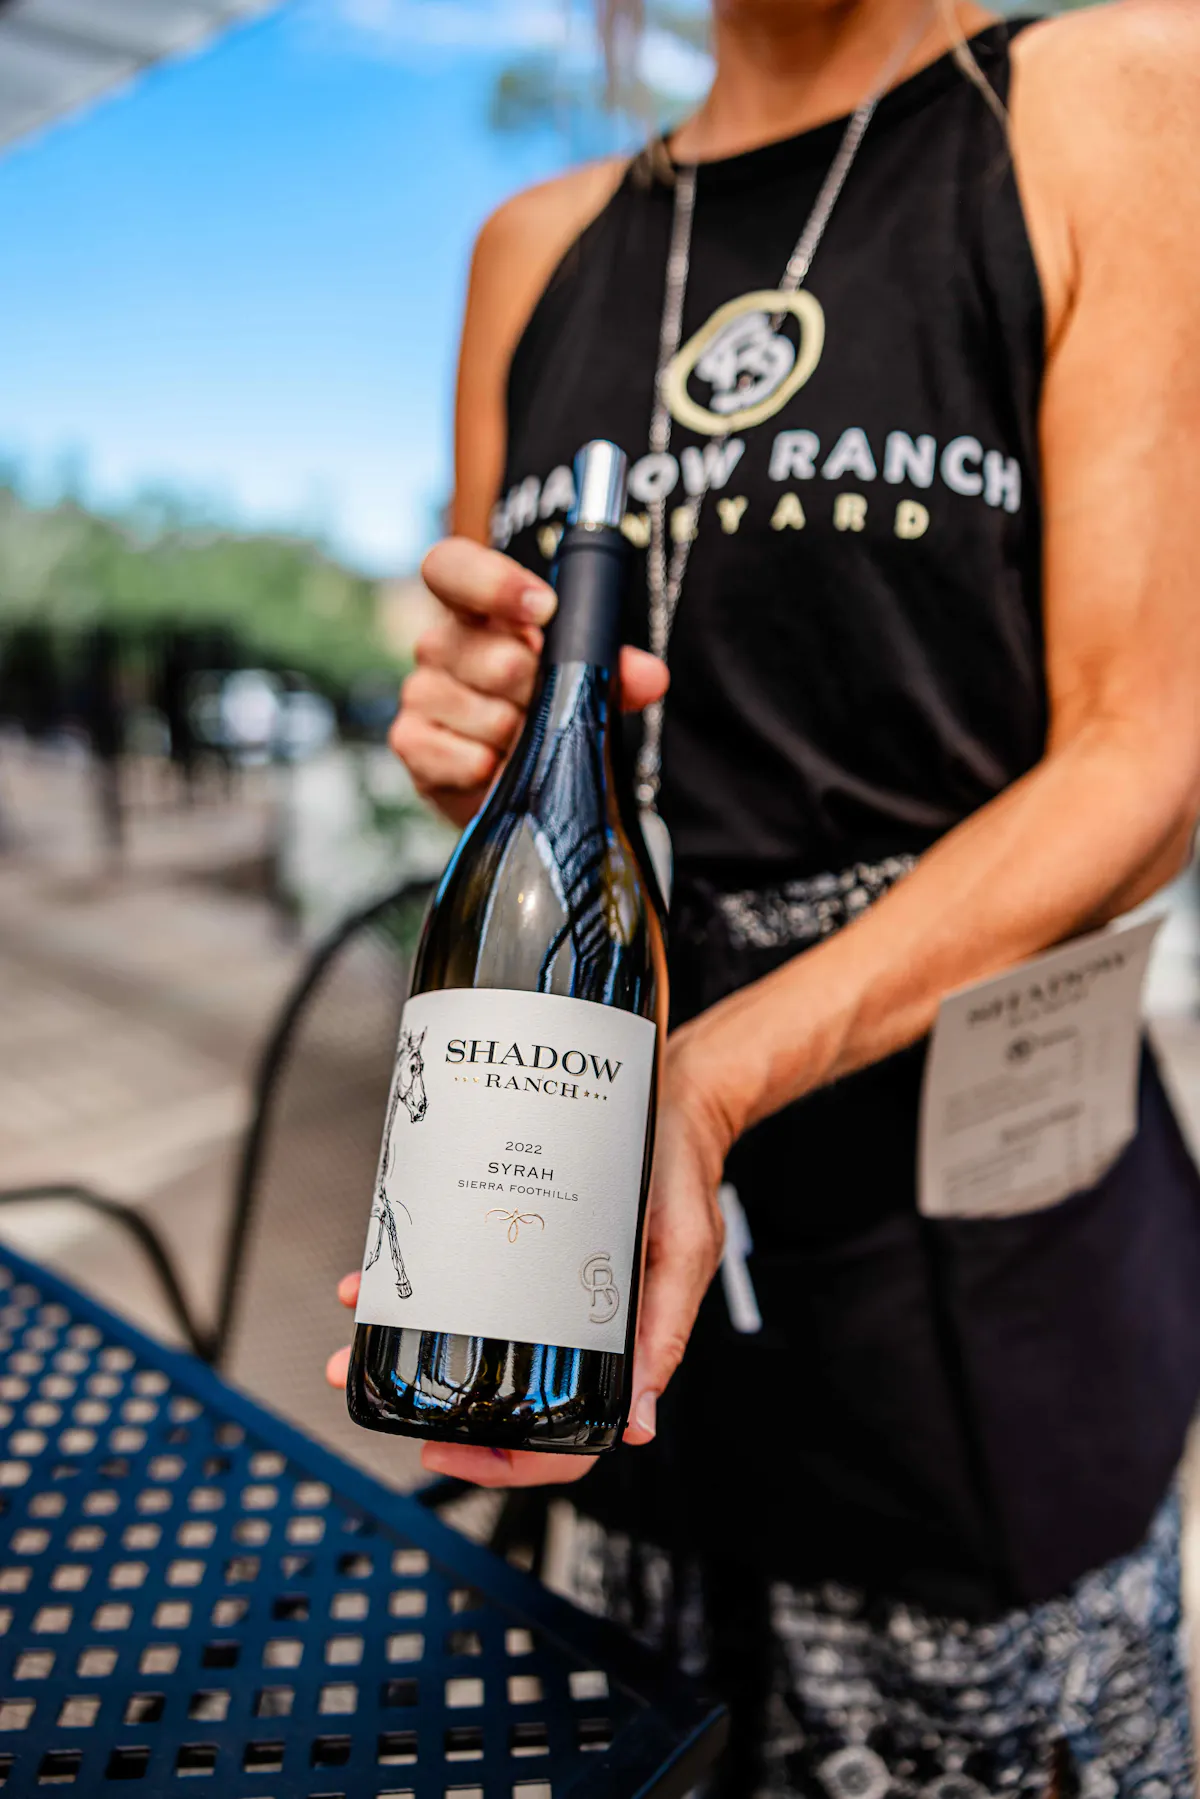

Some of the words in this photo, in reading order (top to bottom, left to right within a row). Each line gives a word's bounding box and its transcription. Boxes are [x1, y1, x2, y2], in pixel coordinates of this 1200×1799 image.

[768, 427, 1022, 513] RANCH
[445, 1038, 624, 1085] SHADOW
[485, 1073, 579, 1100] RANCH
[505, 1141, 543, 1155] 2022
[487, 1161, 554, 1181] SYRAH
[457, 1179, 504, 1192] SIERRA
[509, 1184, 579, 1202] FOOTHILLS
